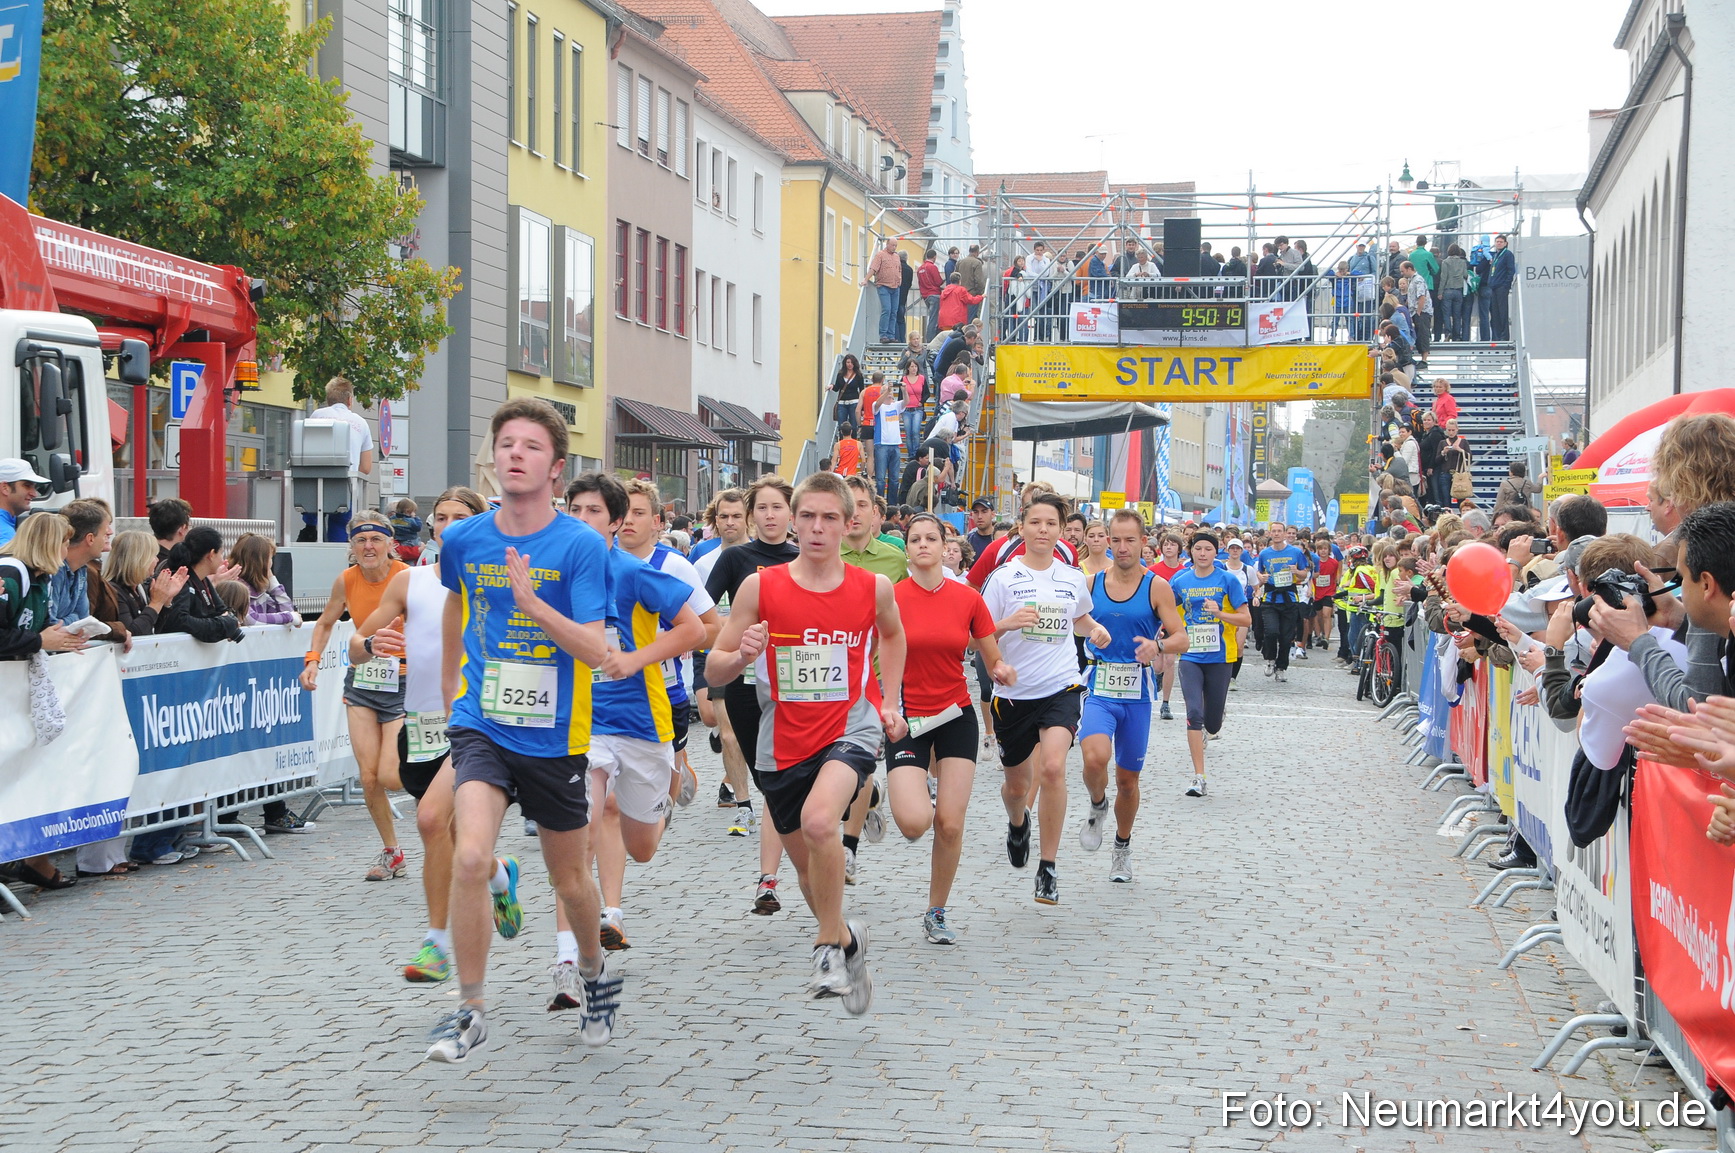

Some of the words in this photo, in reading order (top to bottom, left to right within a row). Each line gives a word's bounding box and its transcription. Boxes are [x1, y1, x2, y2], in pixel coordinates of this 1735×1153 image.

[188, 269, 214, 306] 275
[1060, 371, 1094, 379] Stadtlauf
[1115, 356, 1243, 386] START
[1311, 371, 1346, 379] Stadtlauf
[180, 370, 202, 412] P
[1552, 474, 1593, 482] Typisierung
[1142, 508, 1149, 521] A
[1013, 588, 1037, 596] Pyraser
[1037, 605, 1068, 615] Katharina
[1037, 617, 1068, 631] 5202
[1195, 634, 1217, 644] 5190
[795, 649, 820, 663] Björn
[366, 667, 395, 680] 5187
[797, 666, 843, 684] 5172
[1108, 675, 1138, 687] 5157
[502, 687, 550, 707] 5254
[141, 683, 247, 751] Neumarkter
[248, 676, 302, 735] Tagblatt
